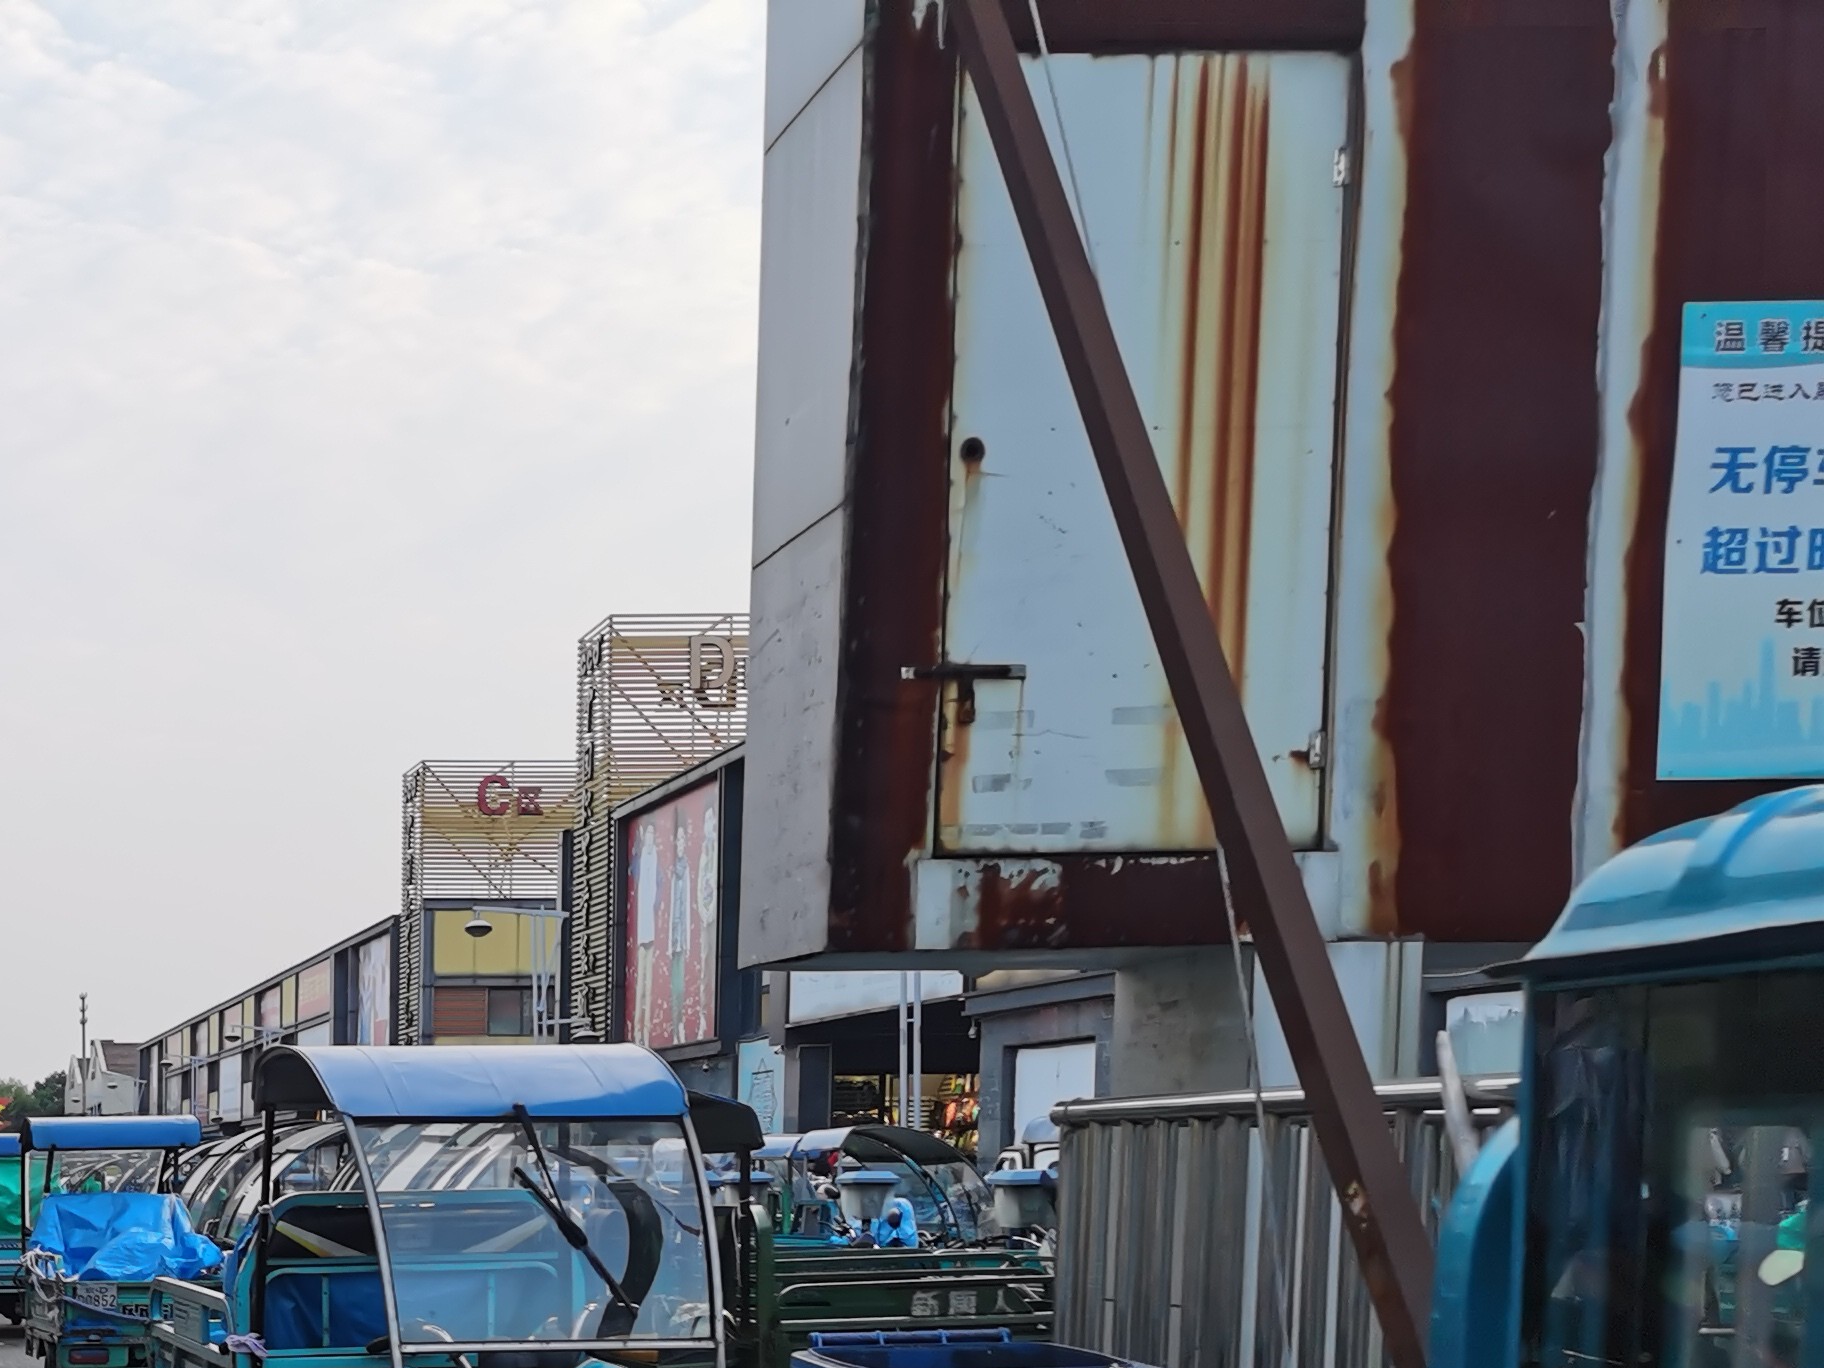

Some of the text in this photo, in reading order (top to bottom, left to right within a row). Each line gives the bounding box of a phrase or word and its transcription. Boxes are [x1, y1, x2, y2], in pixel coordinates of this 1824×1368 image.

[1714, 320, 1824, 353] 温馨提
[1708, 445, 1824, 494] 无停
